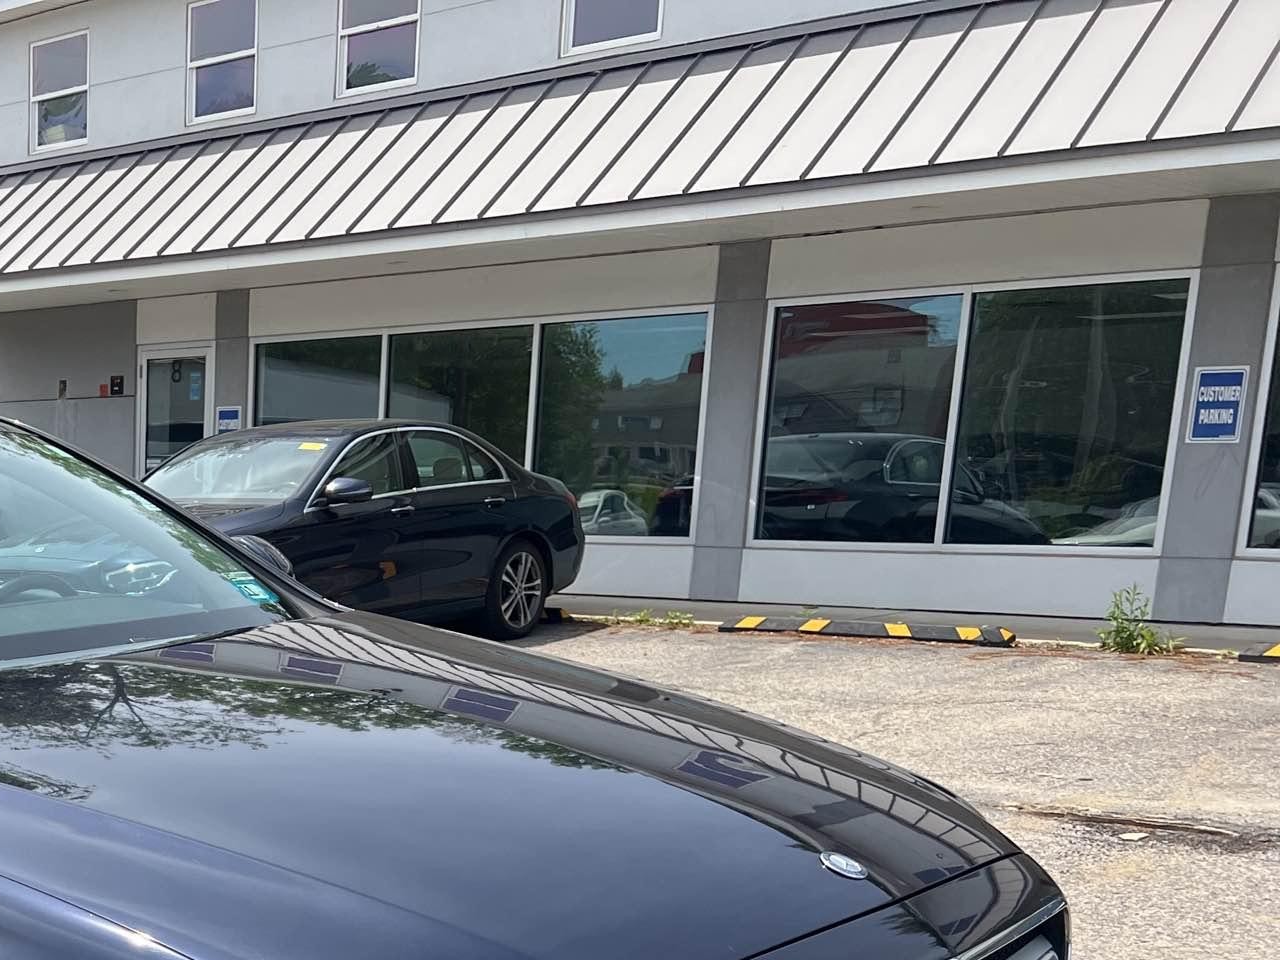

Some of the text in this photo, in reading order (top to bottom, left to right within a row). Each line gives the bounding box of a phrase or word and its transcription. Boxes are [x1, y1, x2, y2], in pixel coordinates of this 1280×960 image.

[171, 360, 182, 383] 8
[1199, 386, 1241, 402] CUSTOMER
[1199, 409, 1234, 424] PARKING
